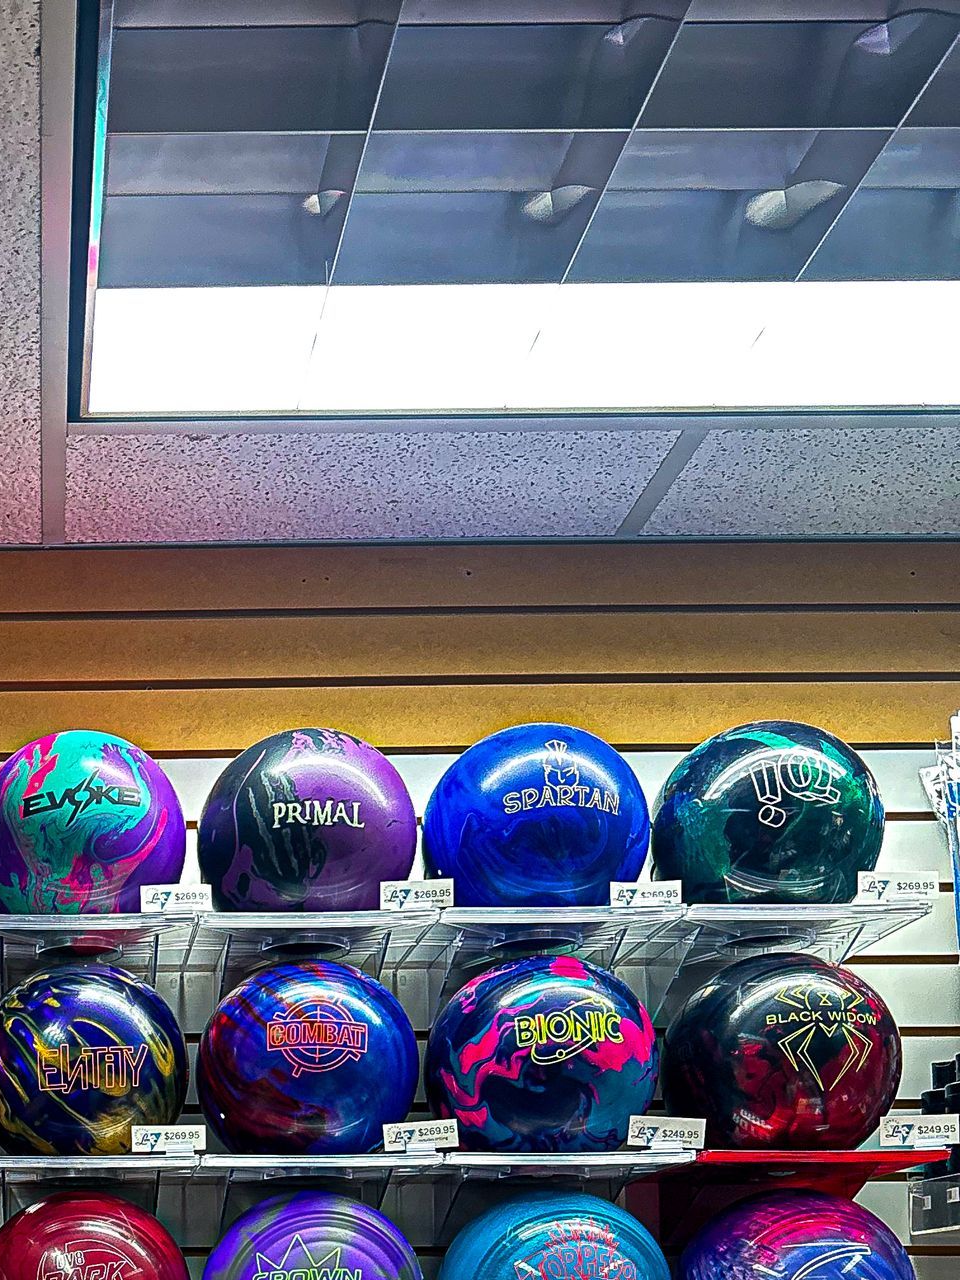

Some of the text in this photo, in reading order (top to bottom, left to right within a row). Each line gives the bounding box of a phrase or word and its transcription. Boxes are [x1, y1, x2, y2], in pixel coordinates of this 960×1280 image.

[22, 770, 142, 826] EVOKE
[504, 784, 619, 815] SPARTAN
[273, 801, 365, 829] PRIMAL
[897, 882, 934, 890] $269.95
[175, 893, 208, 901] $269.95
[414, 889, 450, 899] $269.95
[766, 1008, 878, 1026] BLACK WIDOW
[514, 1009, 623, 1046] BIONIC
[269, 1023, 364, 1047] COMBAT
[418, 1126, 455, 1136] $269.95
[662, 1130, 699, 1138] $249.95
[918, 1125, 956, 1134] $249.95
[164, 1132, 200, 1140] $269.95
